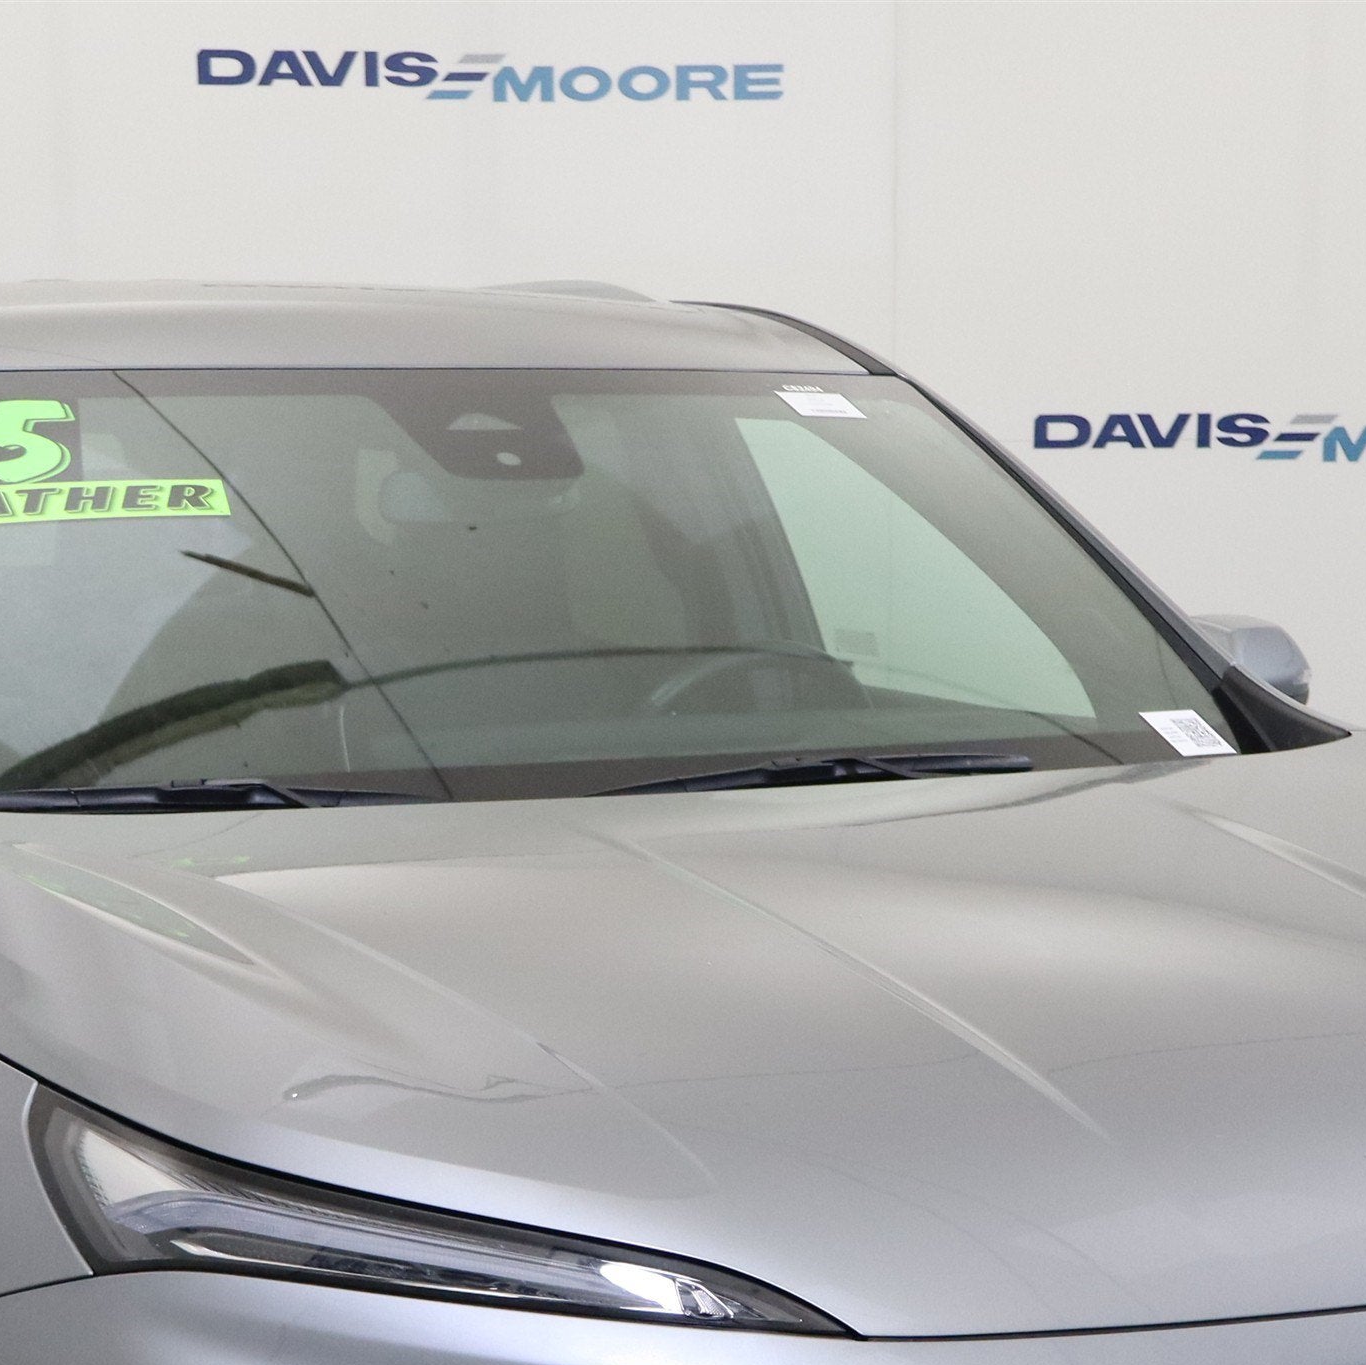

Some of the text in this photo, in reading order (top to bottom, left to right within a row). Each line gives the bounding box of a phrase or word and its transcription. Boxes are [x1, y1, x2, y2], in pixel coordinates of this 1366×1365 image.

[197, 48, 785, 102] DAVIS MOORE
[1034, 413, 1271, 449] DAVIS
